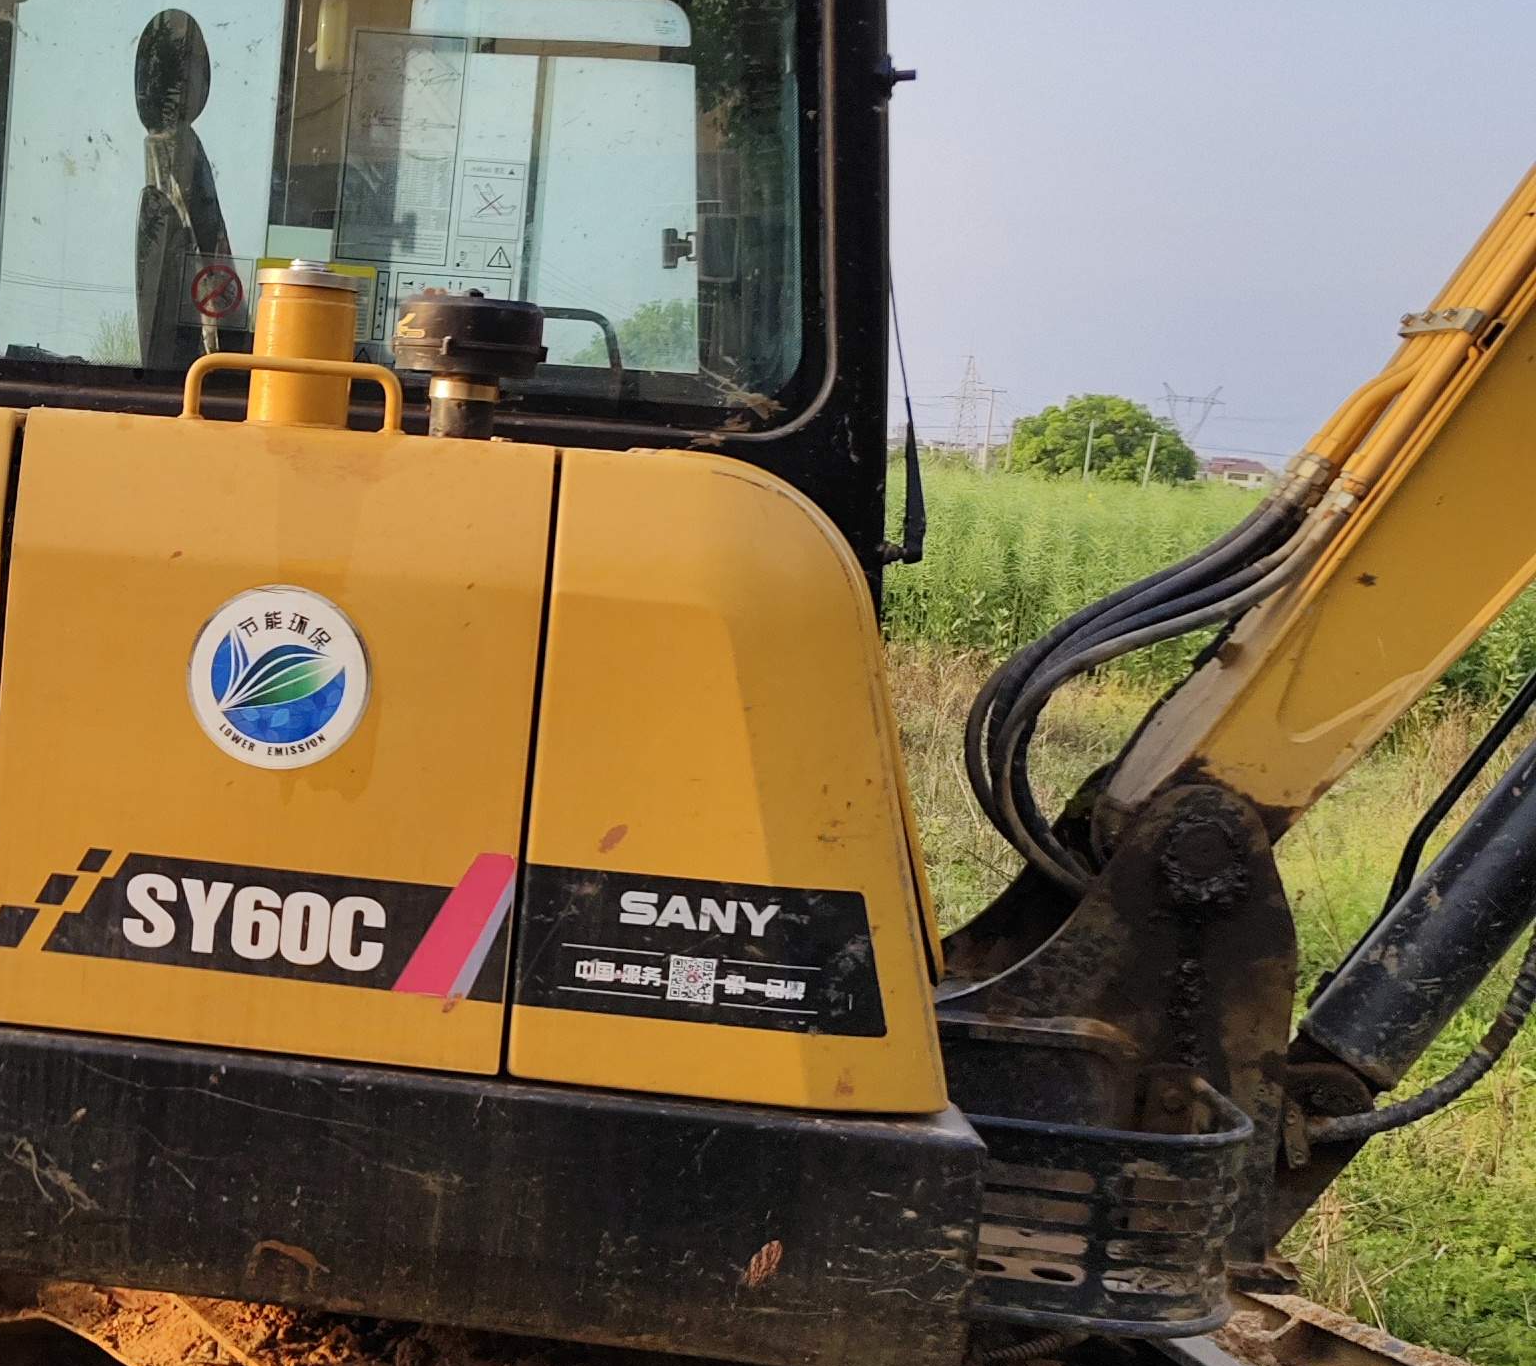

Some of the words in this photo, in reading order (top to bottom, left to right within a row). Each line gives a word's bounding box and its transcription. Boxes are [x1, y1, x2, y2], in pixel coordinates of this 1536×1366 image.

[238, 611, 332, 650] 节能环保
[219, 723, 256, 752] LOWER
[267, 733, 327, 756] EMISSION
[122, 873, 387, 972] SY60C
[619, 890, 782, 937] SANY
